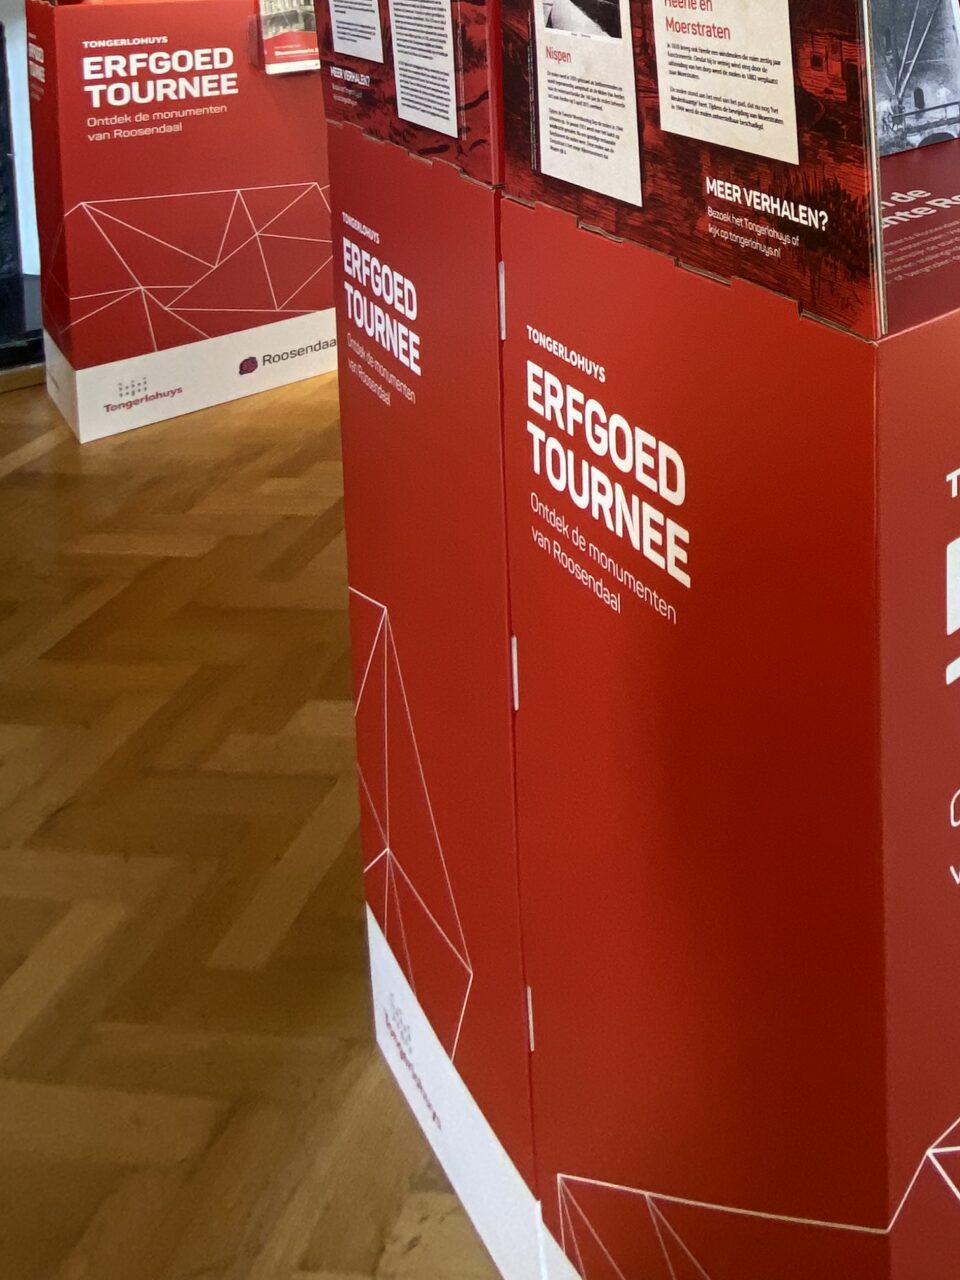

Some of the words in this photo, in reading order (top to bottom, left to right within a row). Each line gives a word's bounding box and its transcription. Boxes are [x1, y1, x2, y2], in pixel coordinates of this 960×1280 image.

[82, 36, 168, 48] TONGERLOHUYS
[665, 16, 731, 40] Moerstraten
[82, 47, 234, 80] ERFGOED
[546, 46, 572, 64] Nispen
[83, 72, 239, 108] TOURNEE
[87, 114, 132, 127] Ontdek
[134, 111, 150, 123] de
[152, 104, 227, 120] monumenten
[87, 131, 111, 142] van
[113, 122, 183, 139] Roosendaal
[706, 176, 742, 204] MEER
[743, 187, 828, 232] VERHALEN?
[707, 206, 732, 223] Bezoek
[732, 215, 744, 228] het
[890, 189, 932, 204] de
[342, 236, 418, 321] ERFGOED
[344, 281, 421, 377] TOURNEE
[103, 386, 183, 414] Tongerlohuys
[262, 337, 337, 367] Roosendaa
[526, 324, 606, 383] TONGERLOHUYS
[526, 360, 686, 507] ERFGOED
[526, 420, 691, 589] TOURNEE
[530, 492, 569, 540] Ontdek
[571, 525, 586, 552] de
[588, 542, 677, 625] monumenten
[531, 525, 551, 555] van
[553, 540, 621, 615] Roosendaal
